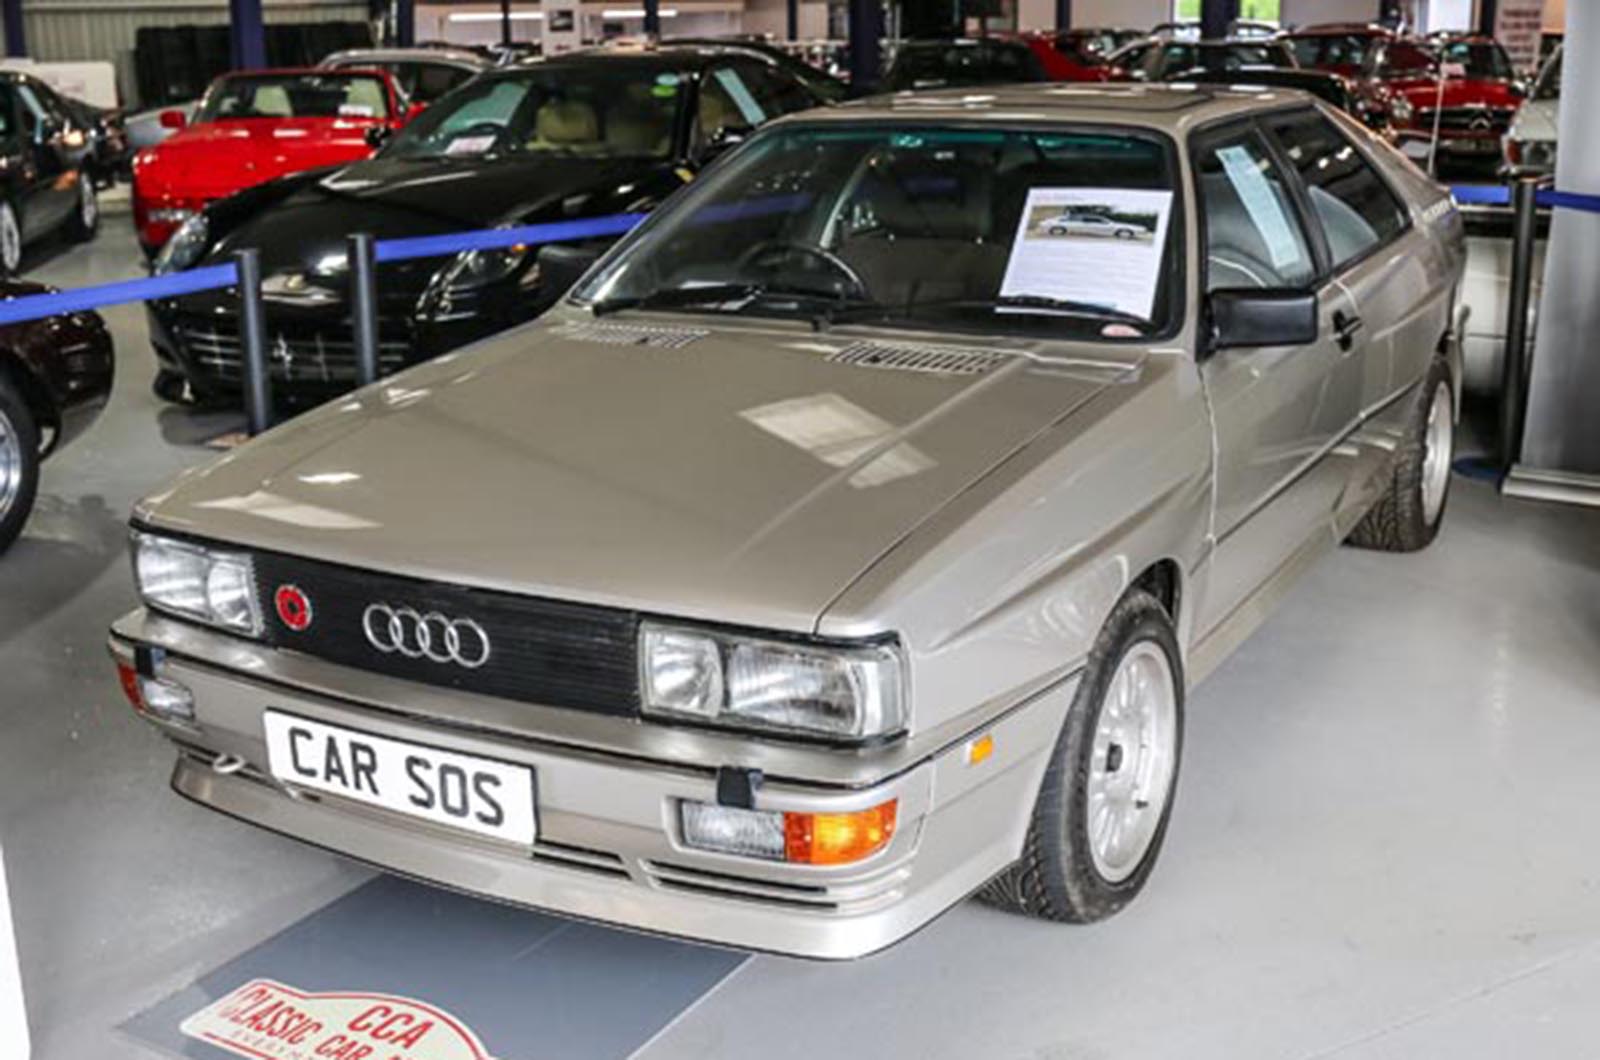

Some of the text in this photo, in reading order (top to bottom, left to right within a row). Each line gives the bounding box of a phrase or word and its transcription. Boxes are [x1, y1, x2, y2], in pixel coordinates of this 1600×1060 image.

[289, 727, 504, 826] CAR SOS
[217, 987, 323, 1045] CLASSIC
[314, 1034, 374, 1060] CAR
[347, 1004, 435, 1050] CCA
